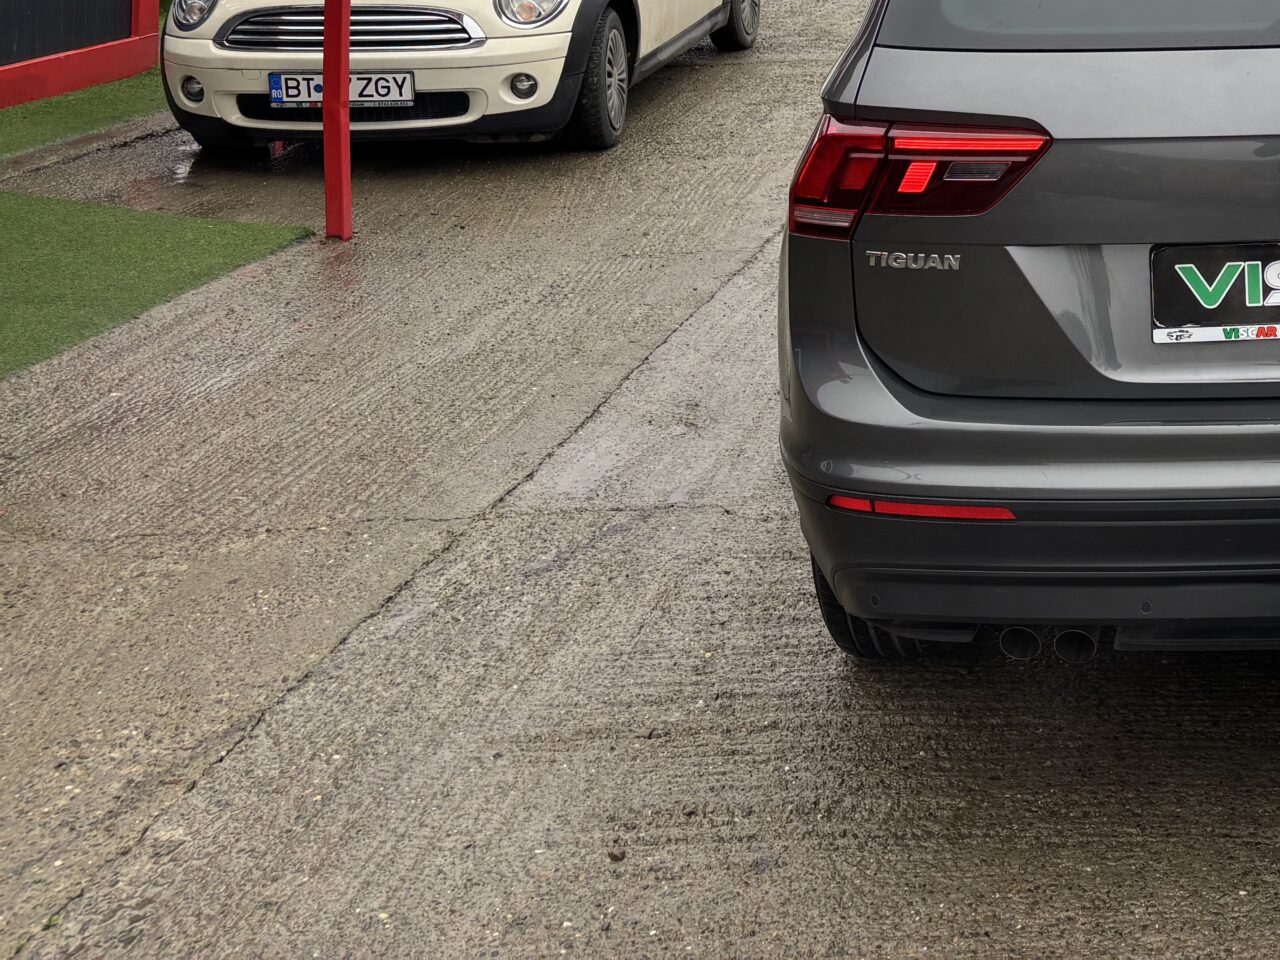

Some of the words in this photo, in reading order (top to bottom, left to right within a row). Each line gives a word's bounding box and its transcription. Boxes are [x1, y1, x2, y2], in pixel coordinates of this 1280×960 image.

[272, 90, 282, 98] RO
[284, 77, 314, 98] BT
[356, 76, 407, 98] ZGY
[865, 250, 961, 270] TIGUAN
[1222, 326, 1278, 340] VISCAR
